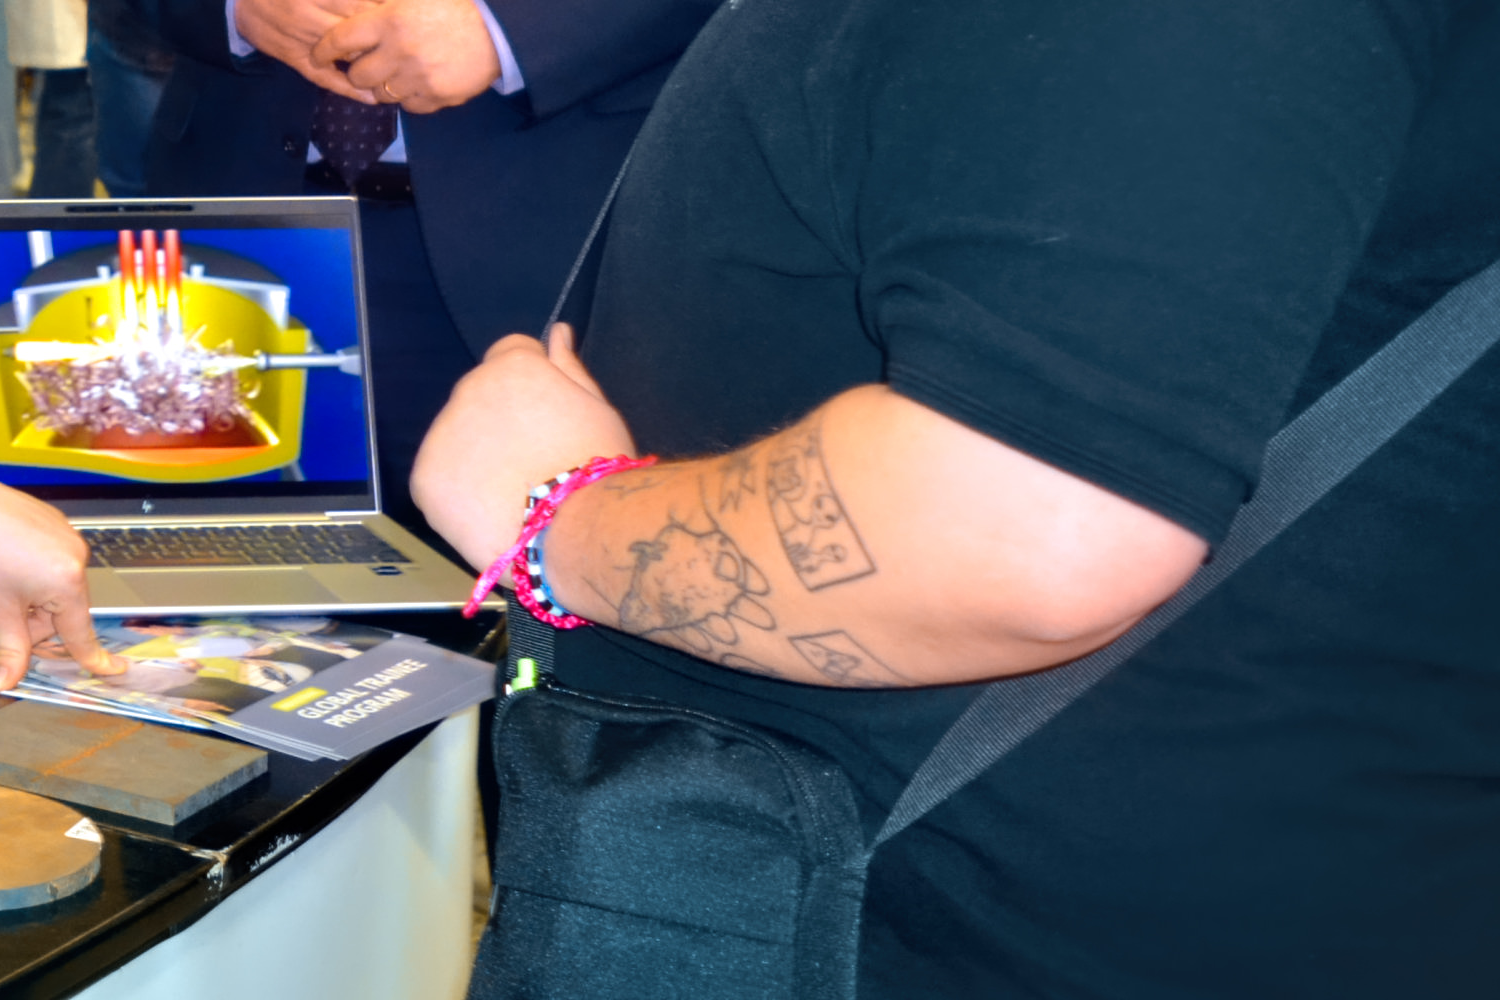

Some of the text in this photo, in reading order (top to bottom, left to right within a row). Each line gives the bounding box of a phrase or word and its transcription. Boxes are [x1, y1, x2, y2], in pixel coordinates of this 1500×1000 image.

[296, 658, 429, 720] GLOBAL TRAINEE
[323, 687, 413, 729] PROGRAM
